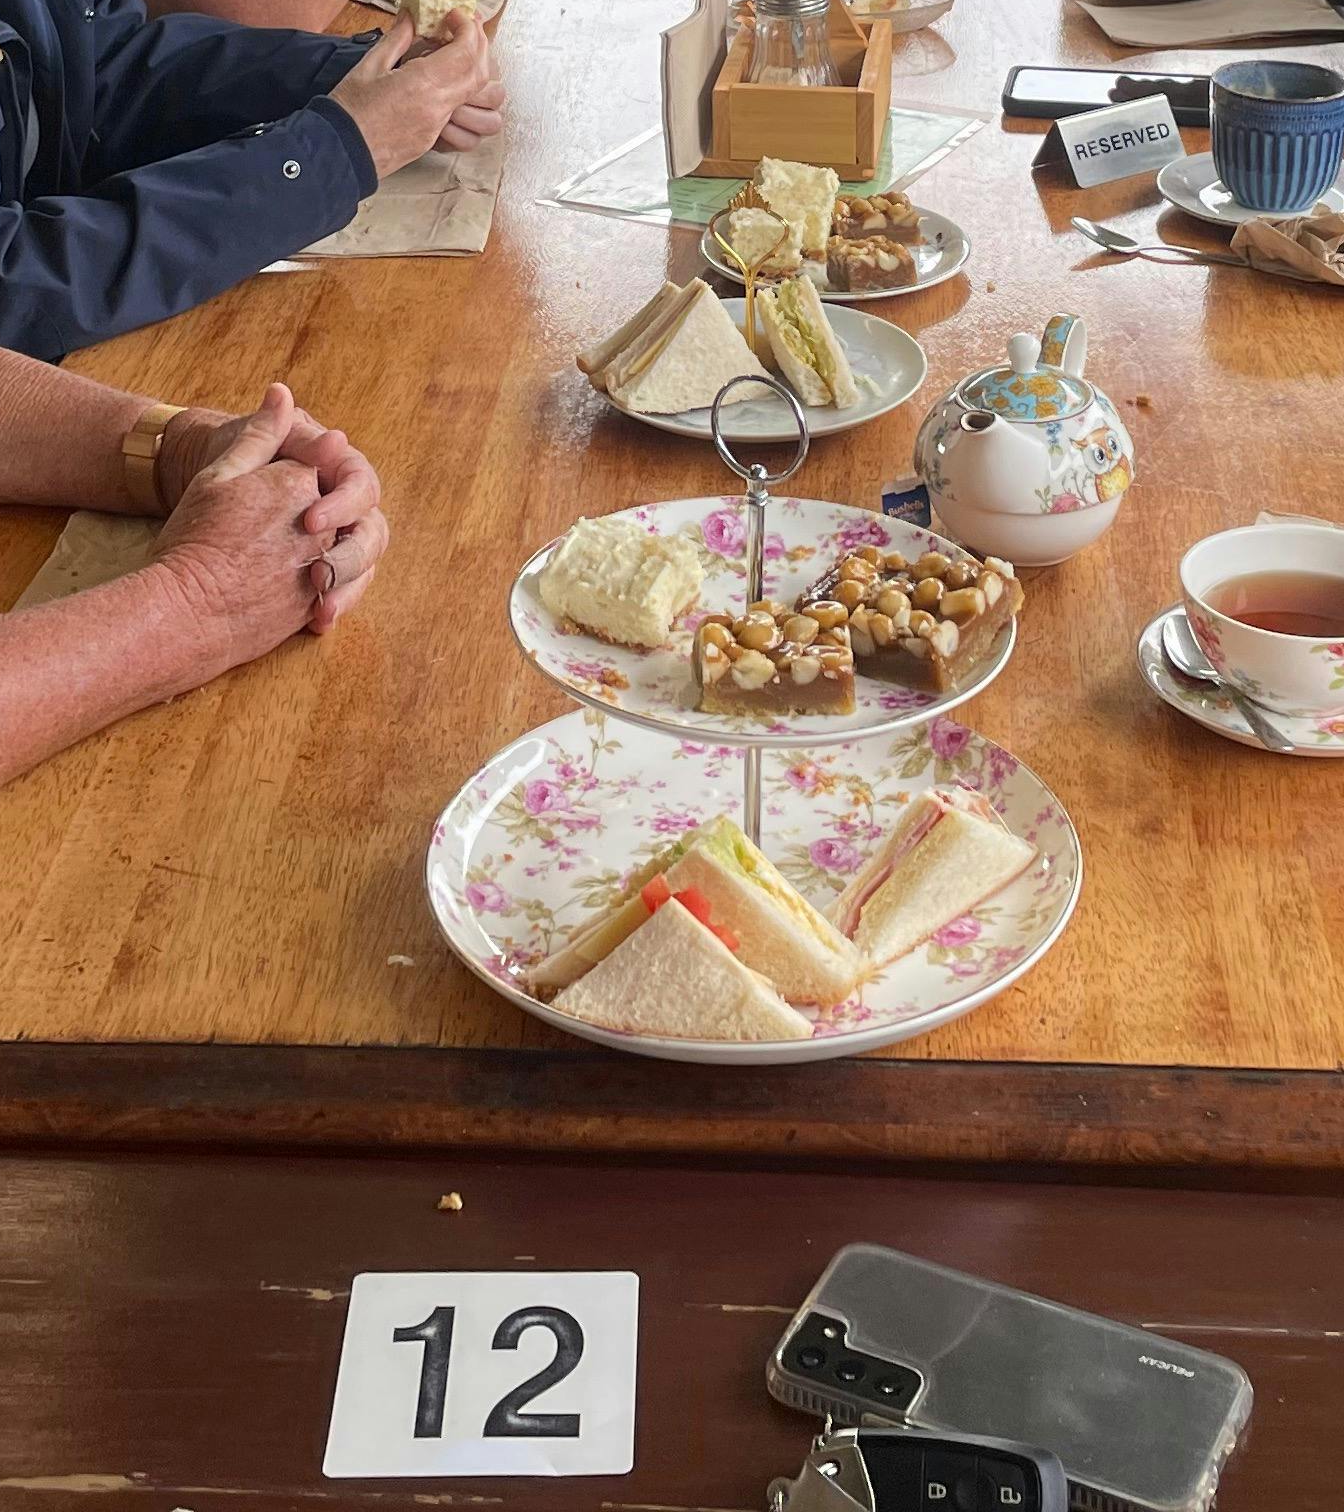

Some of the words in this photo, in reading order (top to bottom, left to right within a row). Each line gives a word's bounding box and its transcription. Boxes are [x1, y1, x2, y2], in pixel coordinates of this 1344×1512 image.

[1074, 122, 1170, 160] RESERVED
[393, 1305, 585, 1438] 12
[1138, 1355, 1195, 1378] PELICAN
